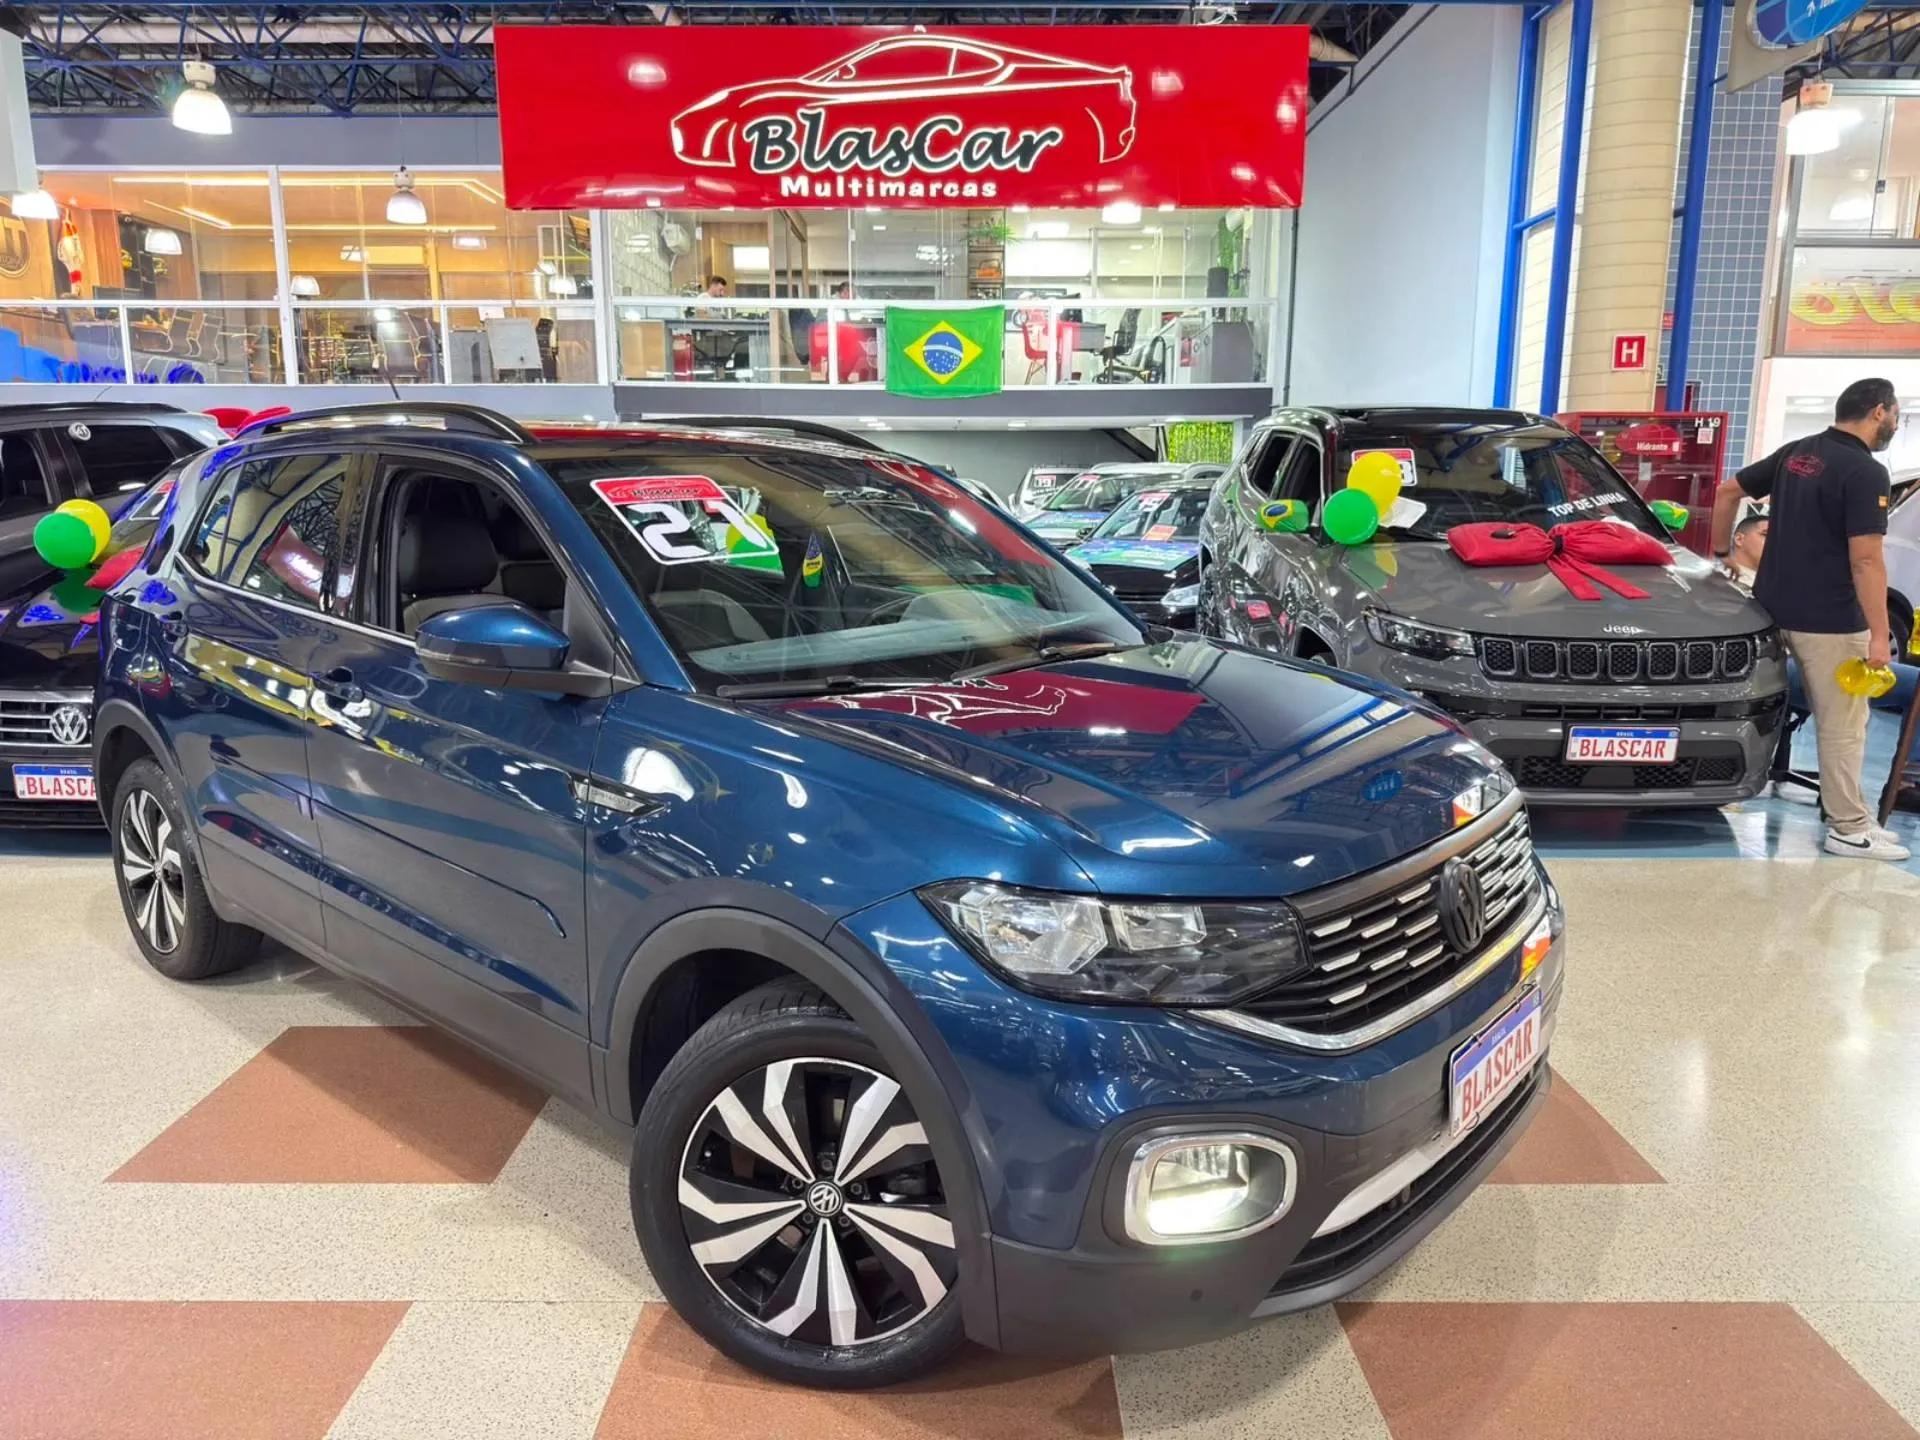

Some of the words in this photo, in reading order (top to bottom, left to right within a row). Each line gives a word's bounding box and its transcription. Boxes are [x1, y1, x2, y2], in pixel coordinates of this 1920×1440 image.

[743, 106, 1063, 178] BlasCar
[780, 176, 998, 199] Multimarcas
[1620, 340, 1639, 363] H
[1694, 417, 1704, 428] H
[1636, 441, 1669, 452] Hidrante
[1547, 502, 1575, 517] TOP
[1572, 498, 1594, 511] DE
[1589, 492, 1628, 506] LINHA
[1602, 624, 1642, 635] Jeep
[1579, 738, 1667, 758] BLASCAR
[1462, 1018, 1533, 1121] BLASCAR
